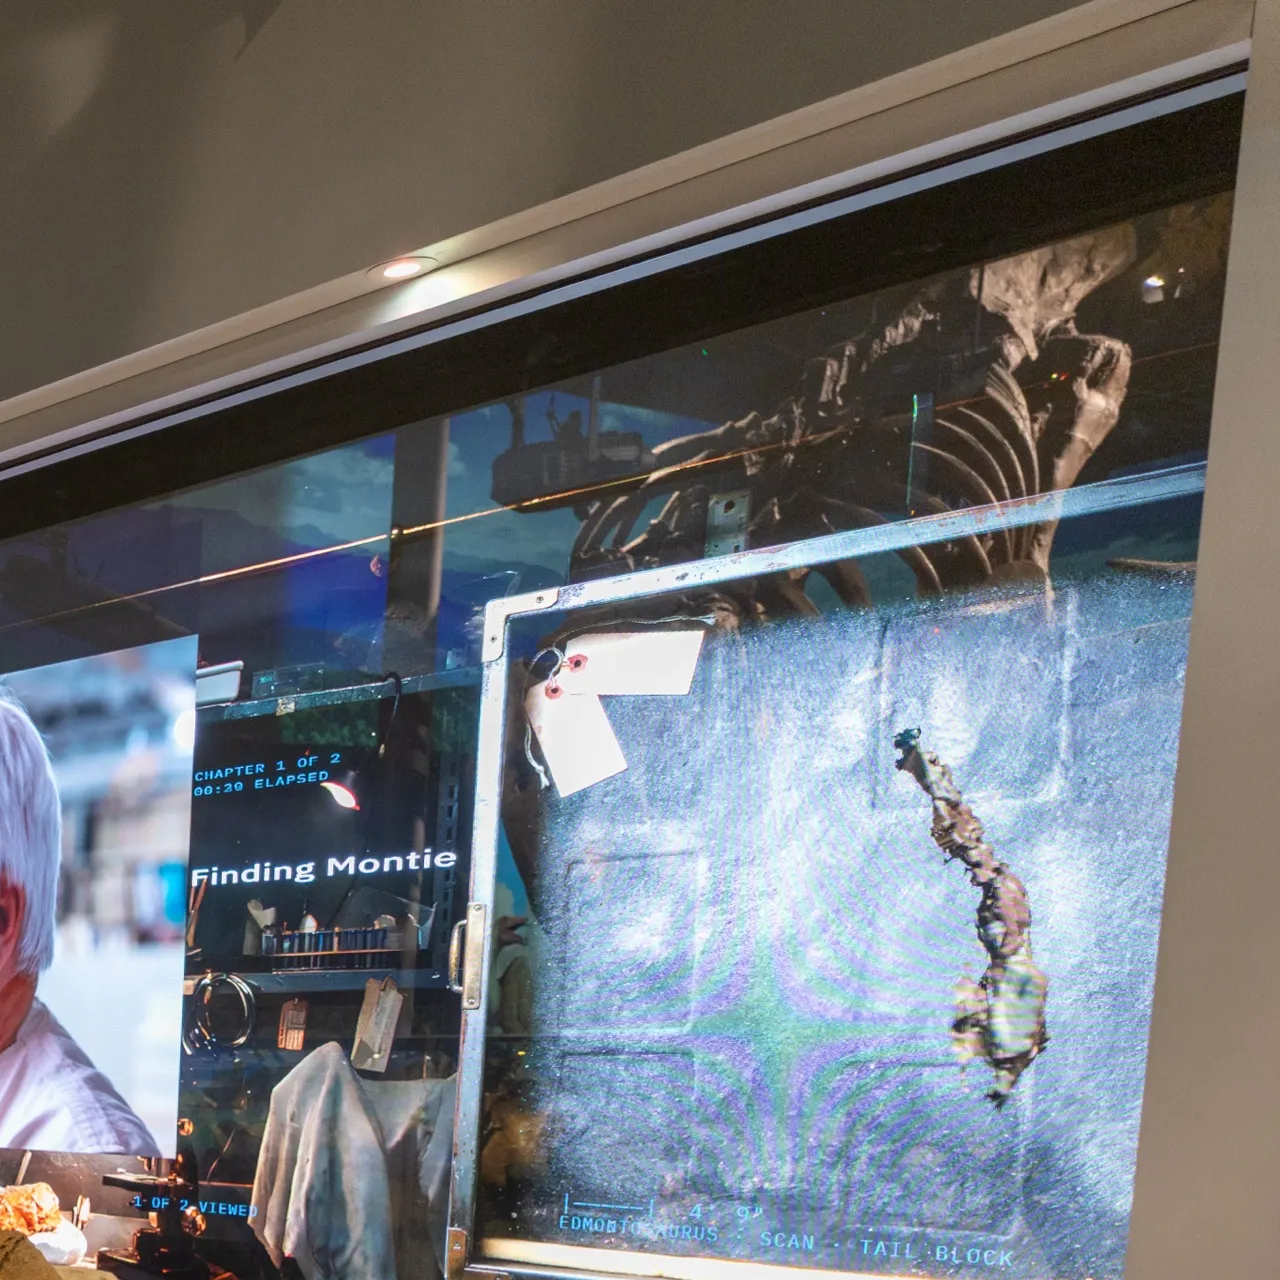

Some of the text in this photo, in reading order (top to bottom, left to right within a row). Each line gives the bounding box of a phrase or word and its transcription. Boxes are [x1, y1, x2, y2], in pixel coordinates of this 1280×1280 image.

[194, 753, 341, 782] CHAPTER 1 OF 2
[254, 771, 329, 789] ELAPSED
[191, 848, 457, 887] Finding Montie
[133, 1195, 258, 1217] 1 OF 2 VIEWED
[760, 1231, 814, 1250] SCAN
[859, 1239, 917, 1259] TAIL
[935, 1245, 1014, 1267] BLOCK
